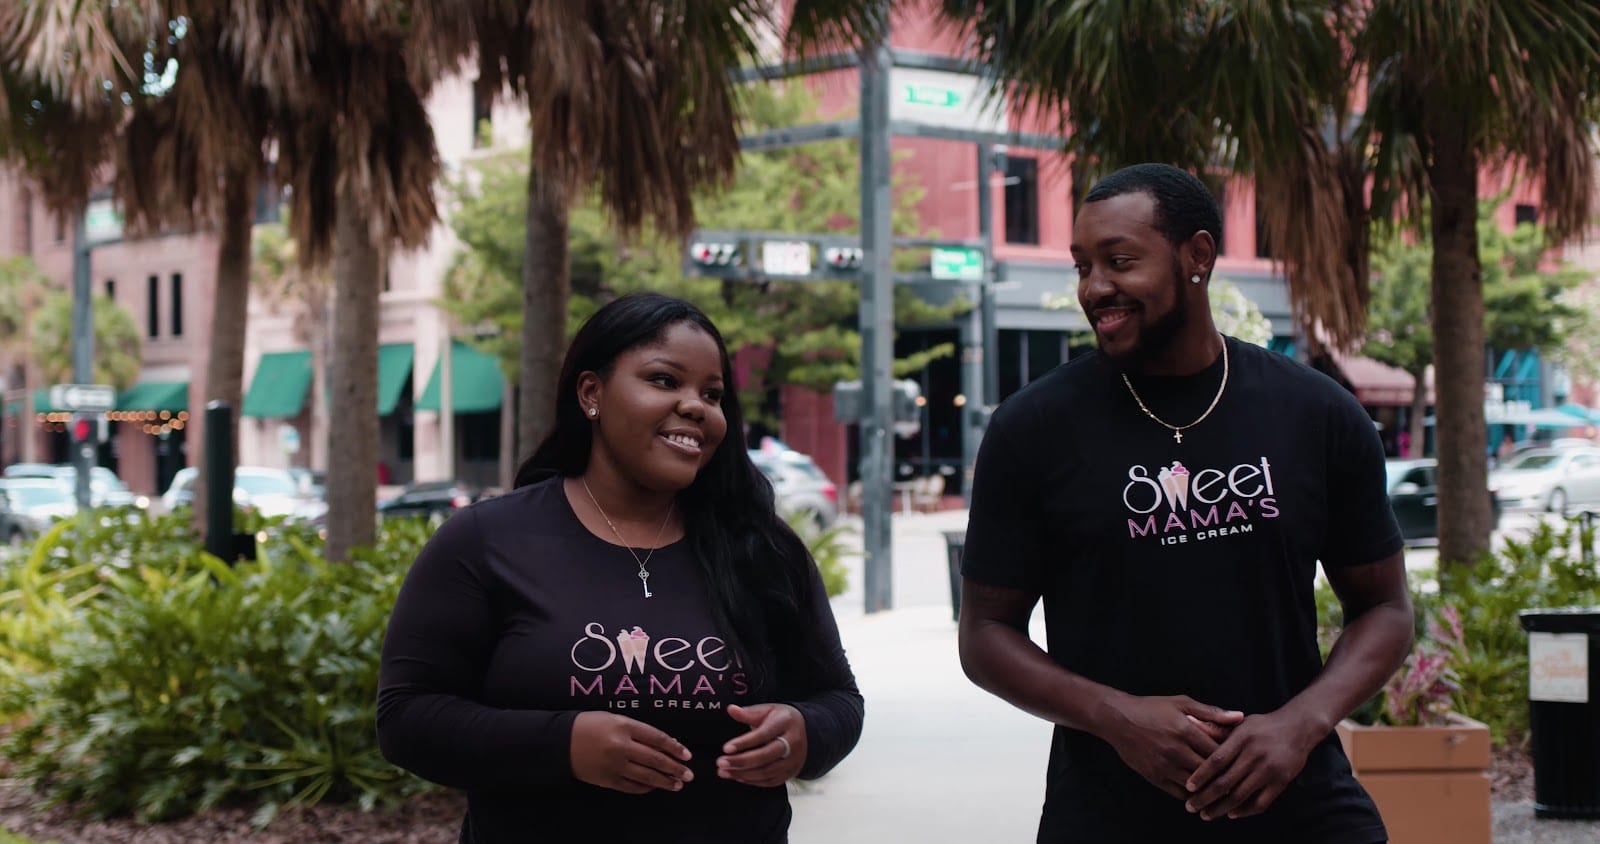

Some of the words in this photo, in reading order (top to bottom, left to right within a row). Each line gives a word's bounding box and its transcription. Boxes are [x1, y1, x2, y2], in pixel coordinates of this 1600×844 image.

[1123, 456, 1274, 513] Sweet
[1127, 497, 1280, 539] MAMA'S
[1161, 534, 1188, 546] ICE
[1196, 523, 1253, 540] CREAM
[570, 672, 748, 697] MAMA'S
[608, 700, 640, 709] ICE
[654, 699, 721, 710] CREAM
